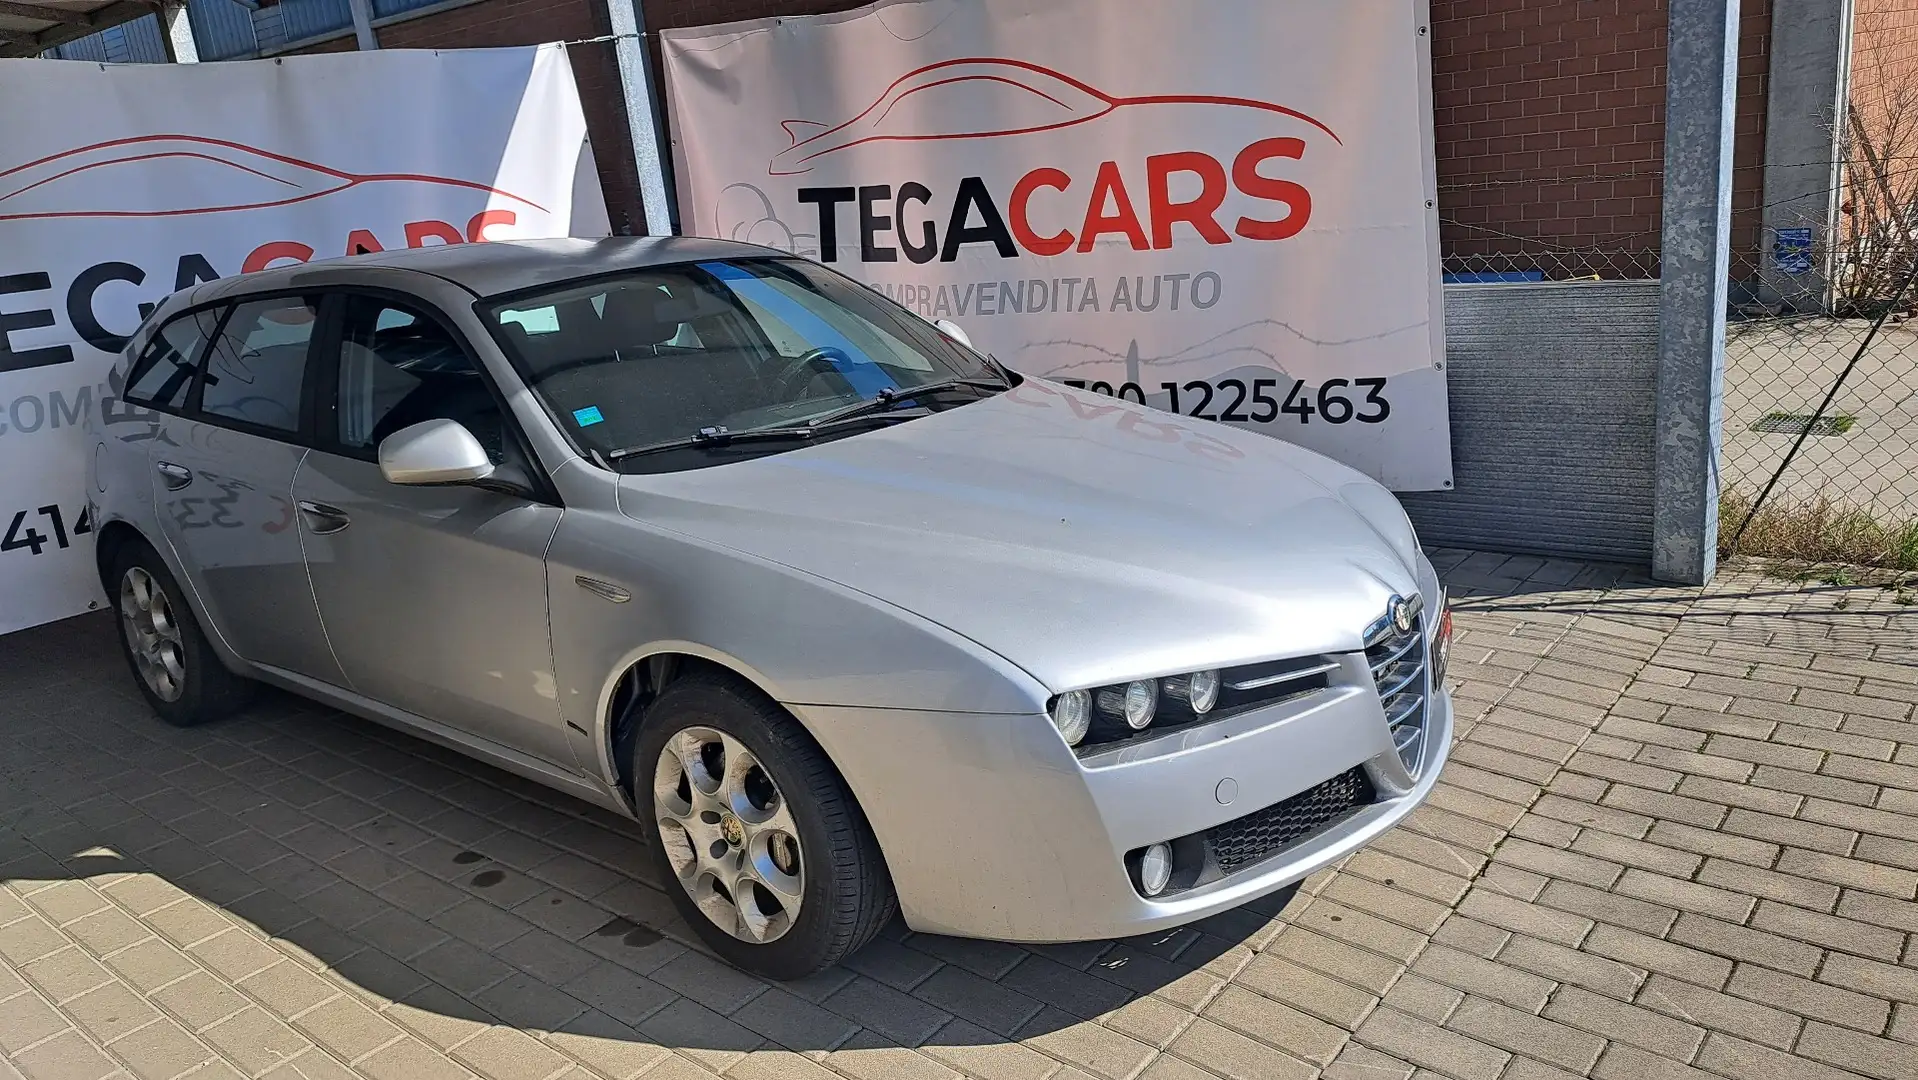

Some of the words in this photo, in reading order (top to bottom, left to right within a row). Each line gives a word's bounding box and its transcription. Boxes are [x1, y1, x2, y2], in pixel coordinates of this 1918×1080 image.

[797, 137, 1312, 264] TEGACARS
[1109, 271, 1223, 313] AUTO
[1161, 377, 1391, 424] 1225463
